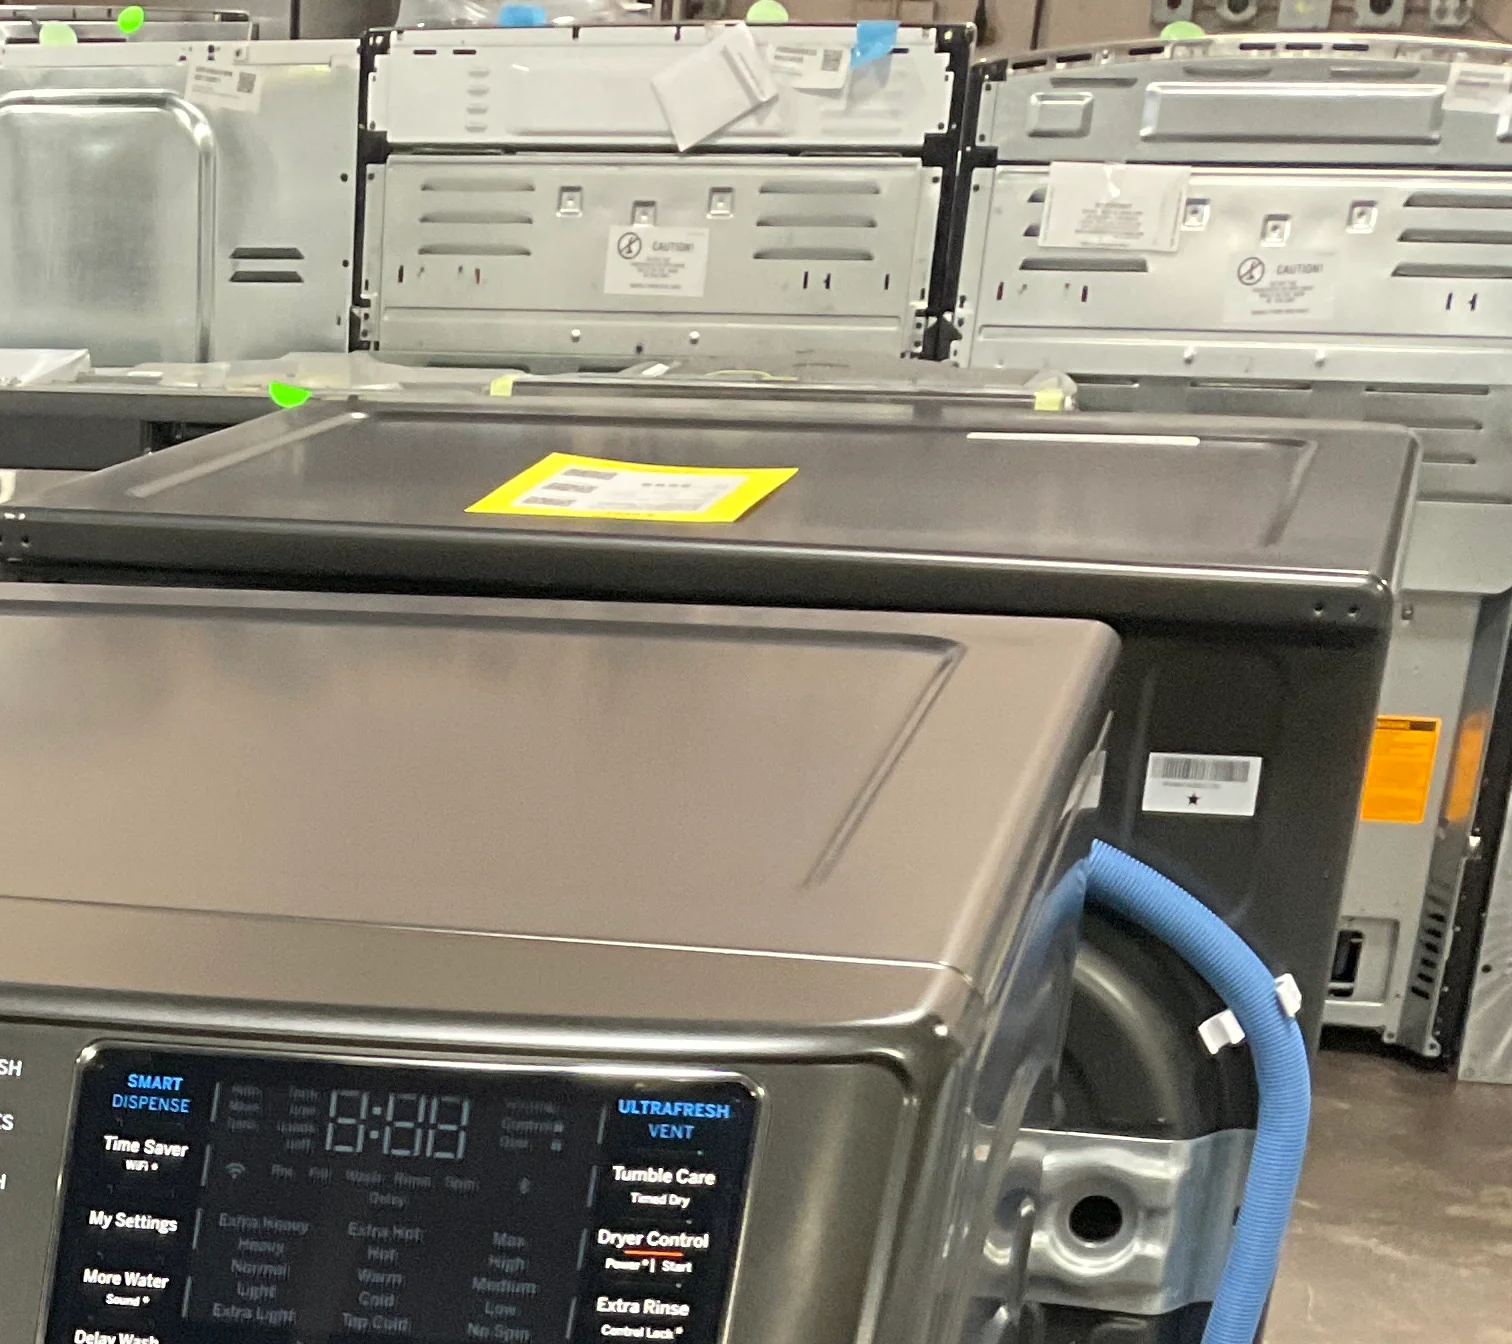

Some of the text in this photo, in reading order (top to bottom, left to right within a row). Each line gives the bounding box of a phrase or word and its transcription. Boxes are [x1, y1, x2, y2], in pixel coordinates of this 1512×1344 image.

[1276, 263, 1324, 275] CAUTION!
[127, 1073, 185, 1092] SMART
[111, 1093, 192, 1114] DISPENSE
[617, 1099, 731, 1119] ULTRAFRESH
[647, 1122, 695, 1140] VENT
[103, 1135, 190, 1158] Time Saver
[612, 1165, 717, 1186] Tumble Care
[630, 1191, 691, 1209] Timed Dry
[88, 1210, 179, 1234] My Settings
[597, 1228, 710, 1249] Dryer Control
[661, 1259, 694, 1273] Start
[82, 1268, 170, 1290] More Water
[105, 1292, 141, 1307] Sound
[596, 1296, 691, 1317] Extra Rinse
[599, 1323, 645, 1339] Control
